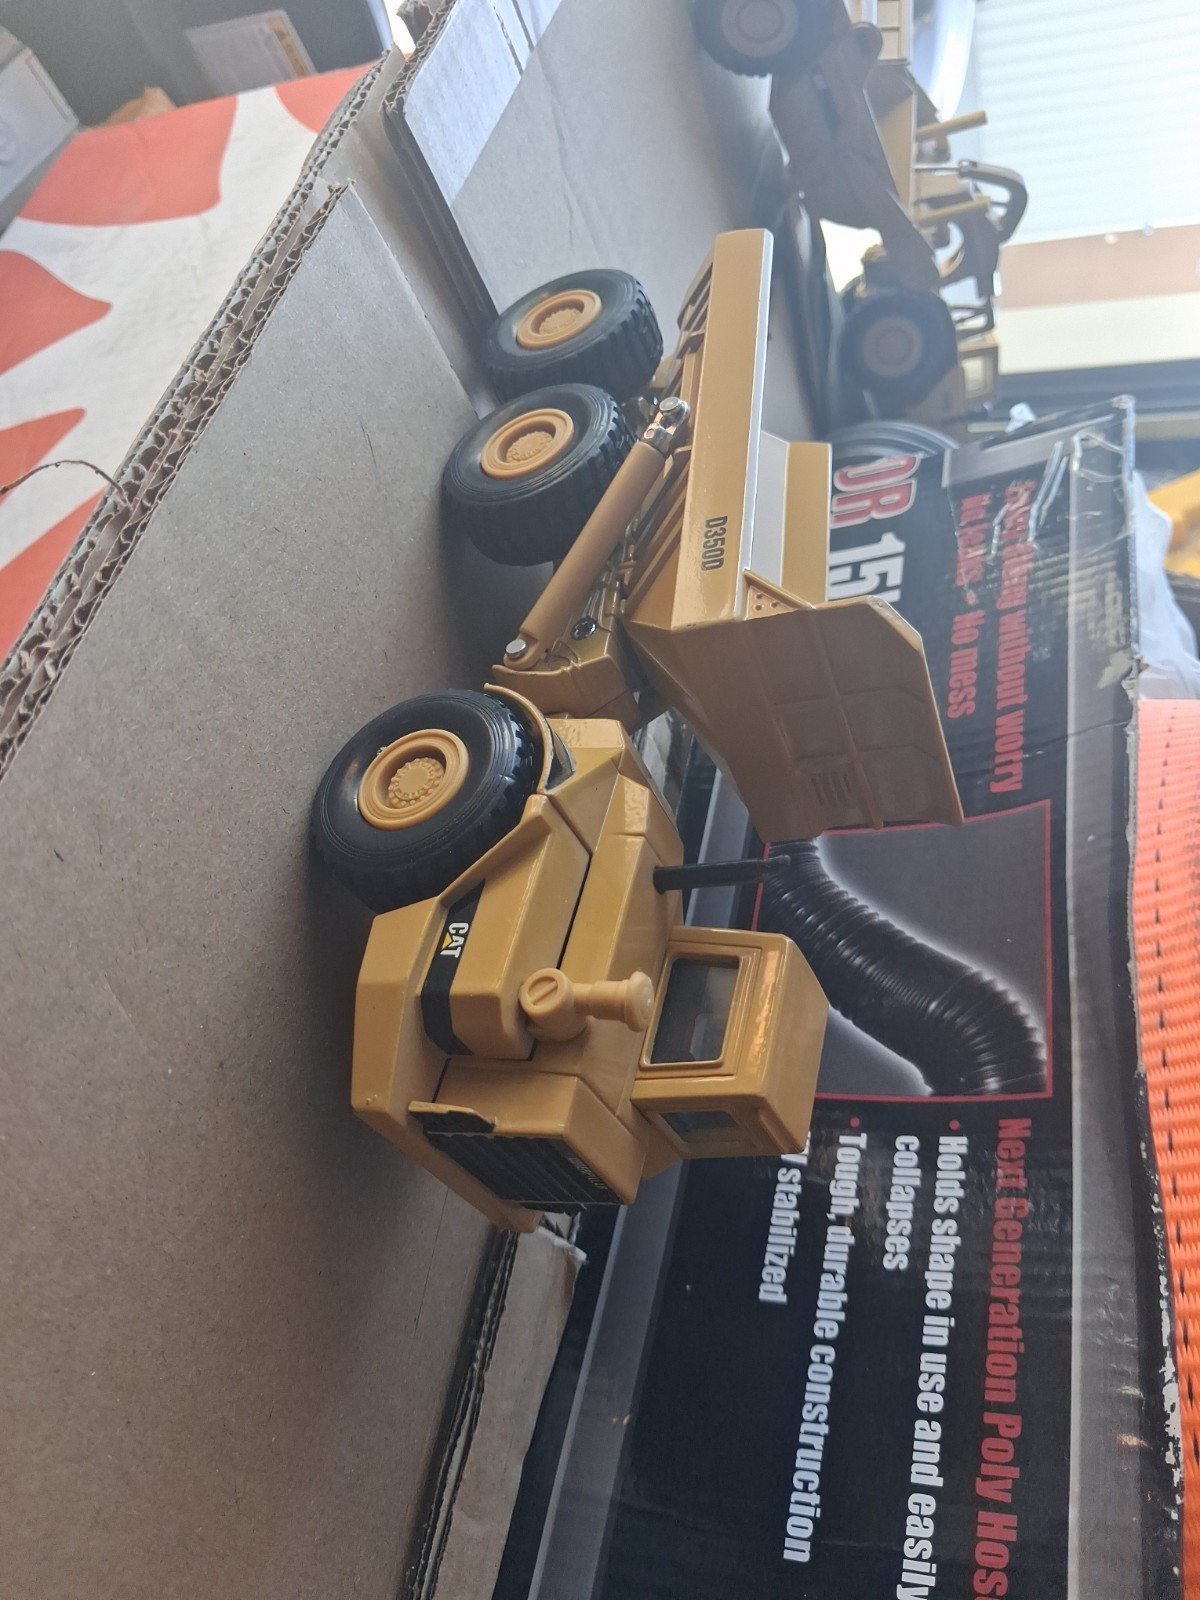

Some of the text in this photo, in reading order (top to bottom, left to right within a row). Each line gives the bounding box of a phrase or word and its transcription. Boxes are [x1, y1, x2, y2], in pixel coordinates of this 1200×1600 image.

[701, 515, 728, 571] D350D
[947, 492, 992, 719] No leaks No mess
[996, 609, 1032, 711] without
[989, 709, 1025, 793] worry
[440, 922, 469, 958] CAT
[758, 1167, 802, 1305] stabilized
[882, 1135, 922, 1270] collapses
[783, 1132, 868, 1563] Tough, durable construction
[896, 1136, 969, 1600] Holds shape in use and easily
[972, 1118, 1033, 1600] Next Generation Poly Hos
